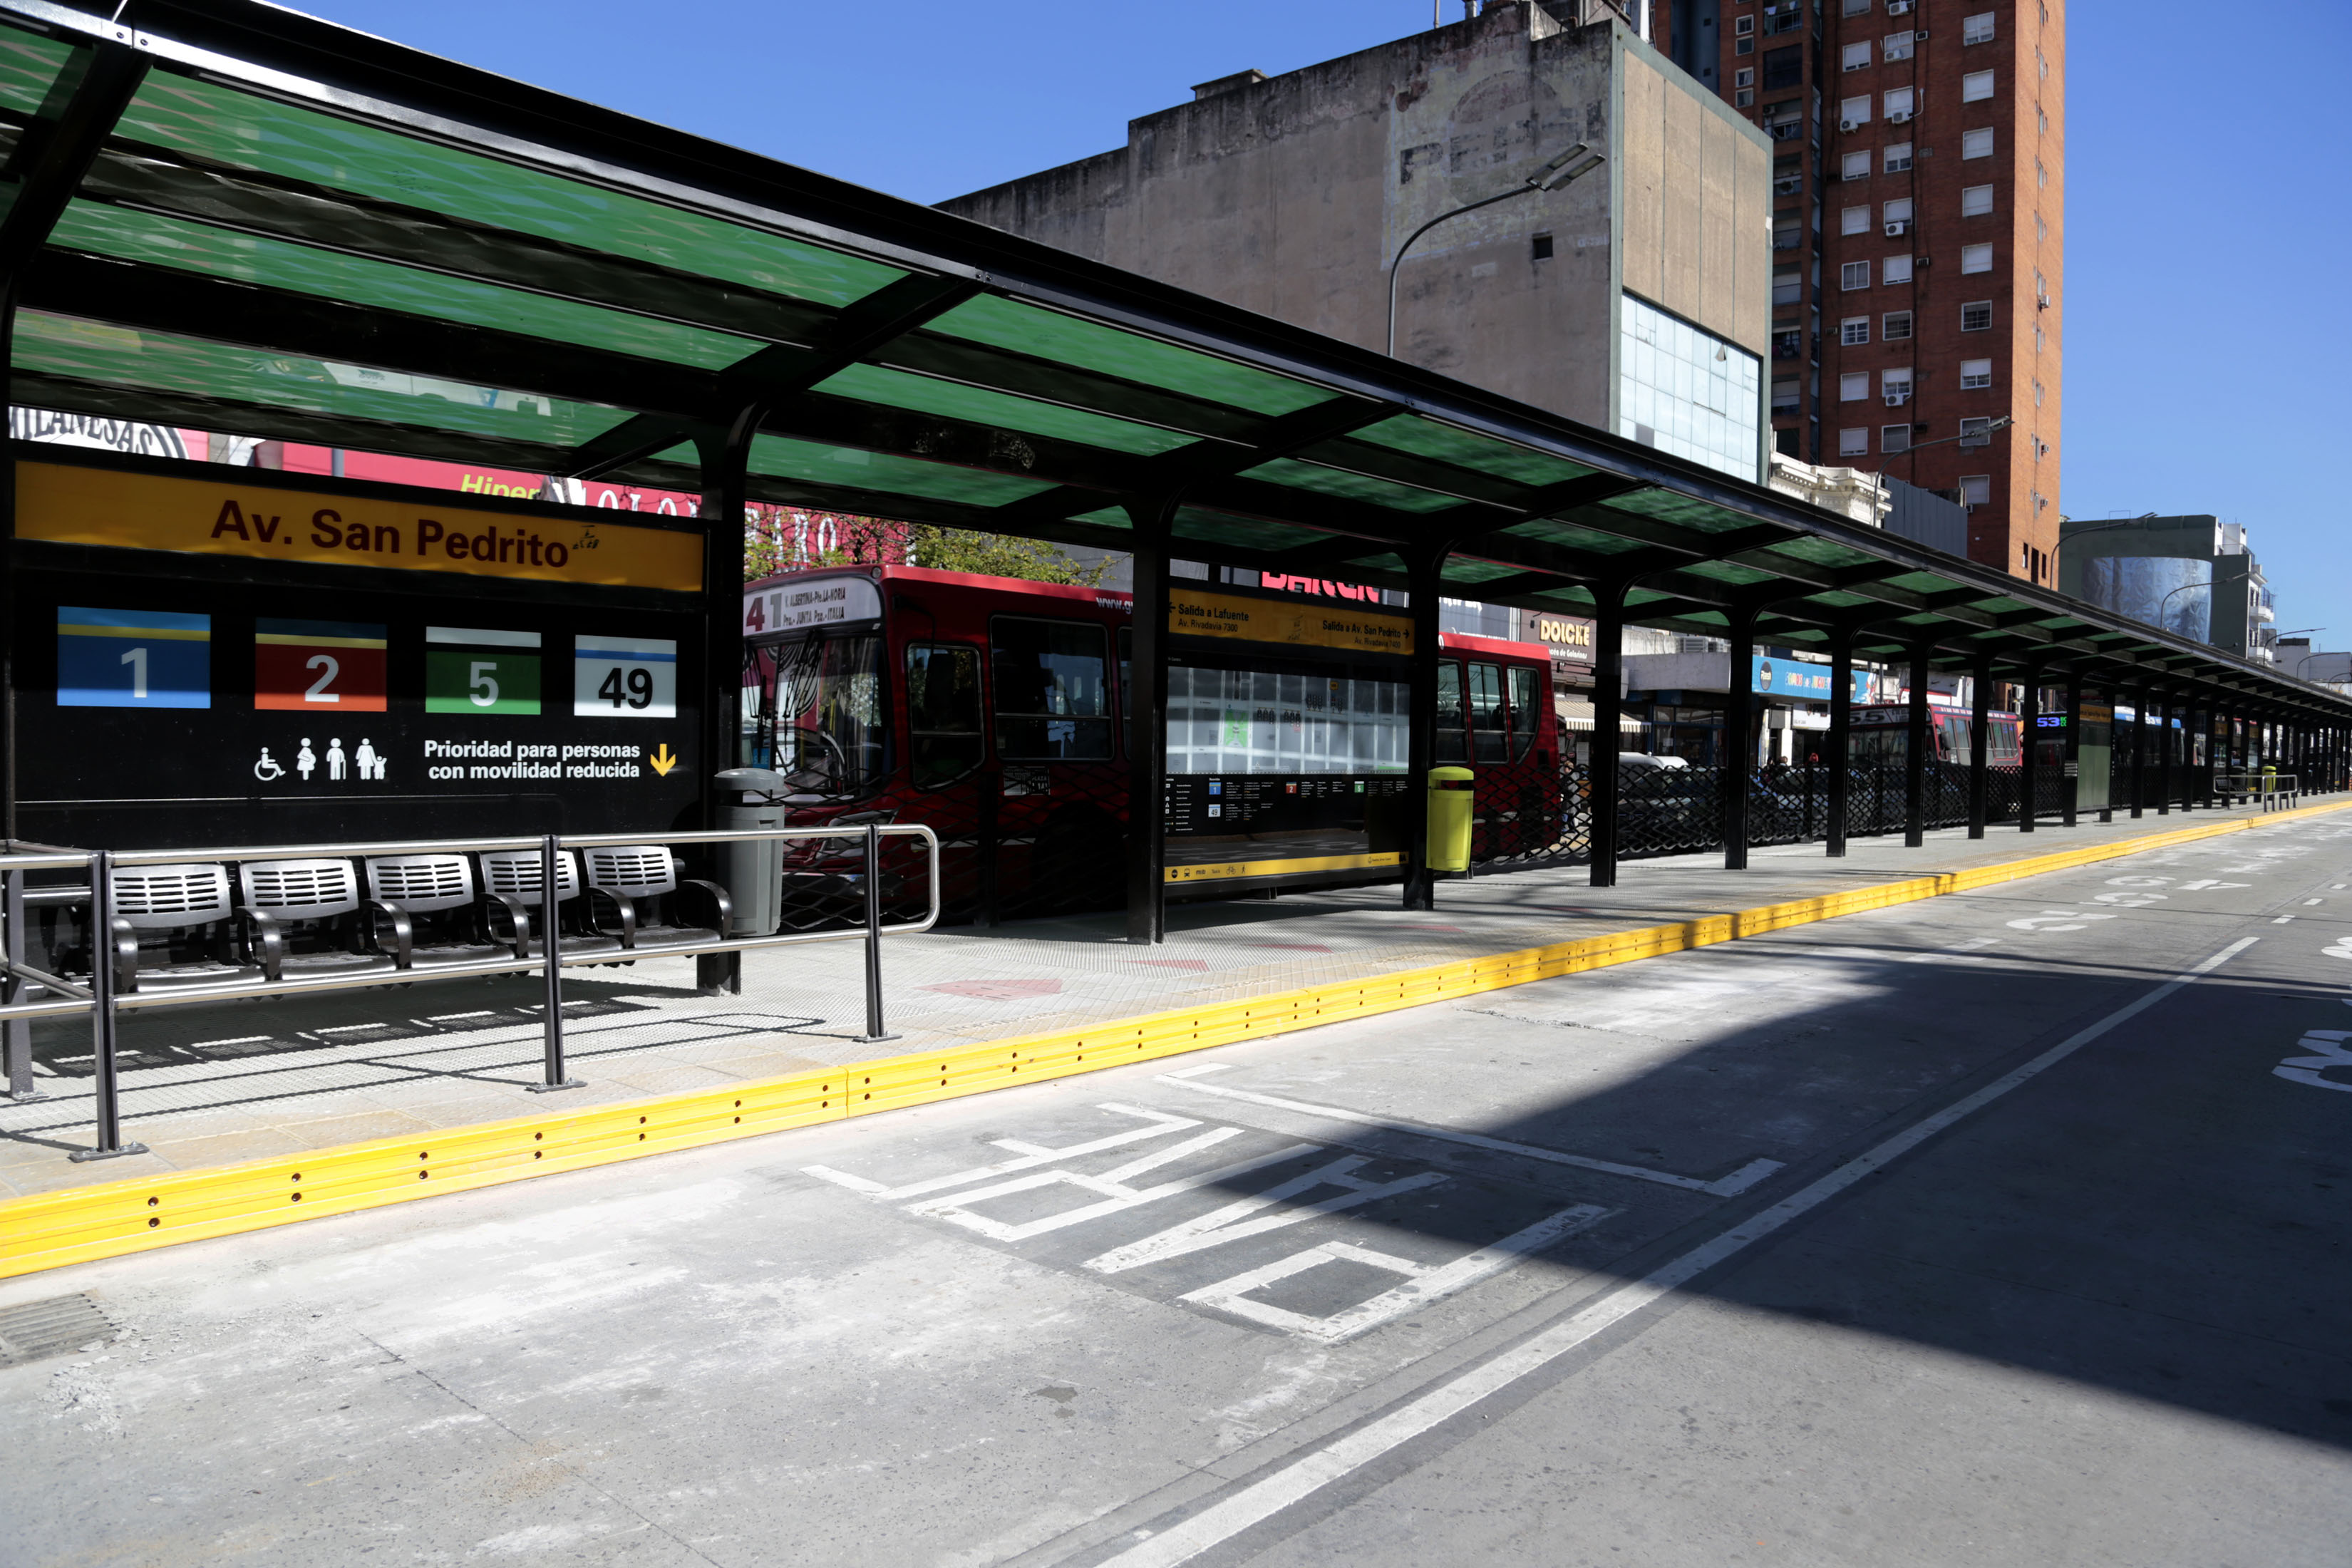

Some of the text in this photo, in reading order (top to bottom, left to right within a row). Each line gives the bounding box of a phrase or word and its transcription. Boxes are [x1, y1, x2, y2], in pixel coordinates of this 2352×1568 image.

[211, 500, 292, 545] Av.
[311, 509, 401, 554] San
[417, 519, 569, 569] Pedrito
[746, 593, 783, 632] 41
[1178, 604, 1249, 621] Salida a Lafuente
[1178, 618, 1239, 633] Av. Rivadavia 7300
[1322, 620, 1344, 632] Salida
[1345, 624, 1351, 632] a
[1351, 624, 1363, 634] Av.
[1364, 624, 1377, 635] San
[1378, 626, 1402, 639] Pedrito
[1540, 619, 1590, 646] DOLCHE
[120, 646, 148, 698] 1
[304, 654, 340, 703] 2
[469, 661, 500, 707] 5
[598, 667, 654, 710] 49
[2037, 716, 2060, 727] 53
[425, 740, 641, 761] Prioridad para personas
[428, 761, 640, 780] con movilidad reducida
